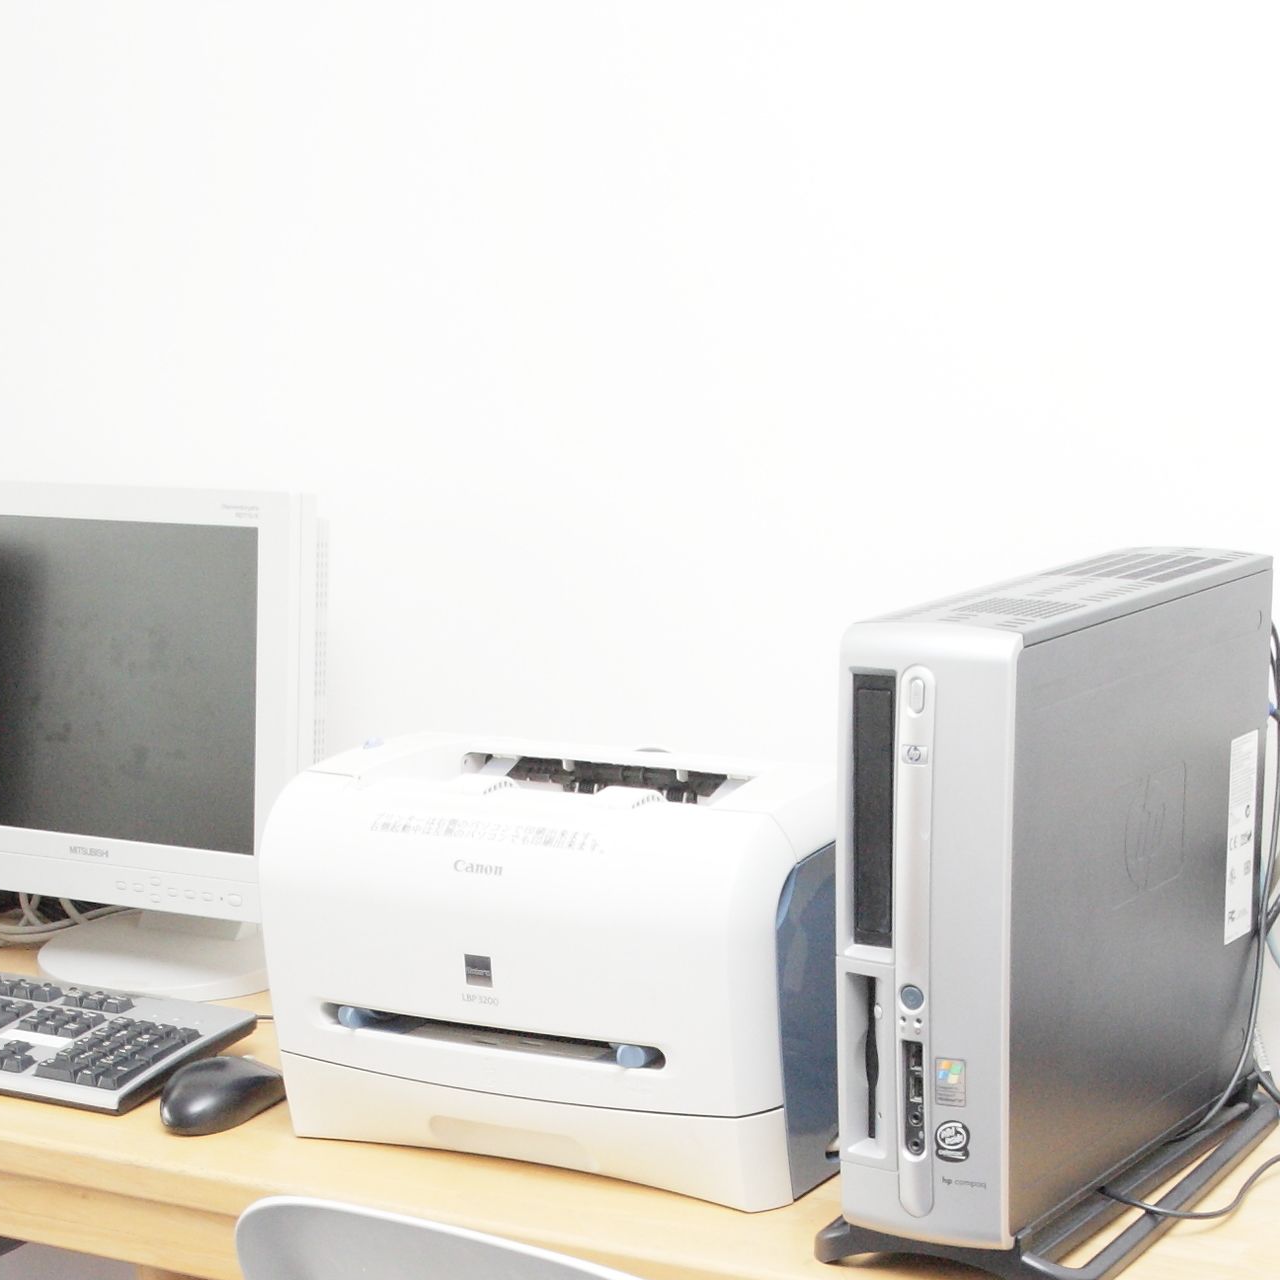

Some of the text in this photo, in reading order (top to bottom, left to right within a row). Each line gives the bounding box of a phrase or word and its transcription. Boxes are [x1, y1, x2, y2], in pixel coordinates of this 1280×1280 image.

[69, 846, 109, 858] MITSUBISHI
[453, 859, 503, 876] Canon
[942, 1176, 987, 1190] hp compaq
